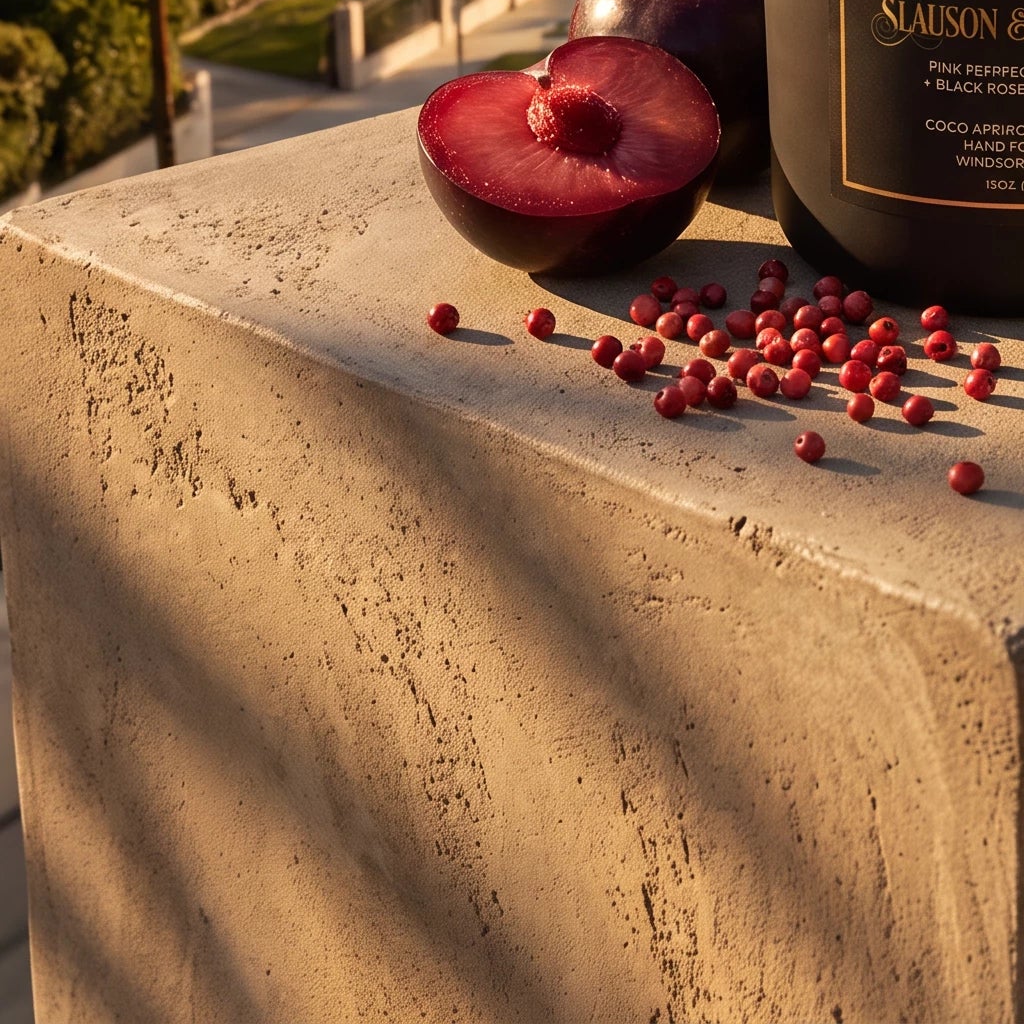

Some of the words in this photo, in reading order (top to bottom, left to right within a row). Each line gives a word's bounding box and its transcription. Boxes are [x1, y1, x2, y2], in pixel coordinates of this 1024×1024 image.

[929, 60, 962, 76] PINK
[923, 78, 931, 87] +
[936, 78, 984, 94] BLACK
[925, 118, 969, 134] COCO
[963, 139, 1006, 153] HAND
[955, 155, 1024, 169] WINDSOR
